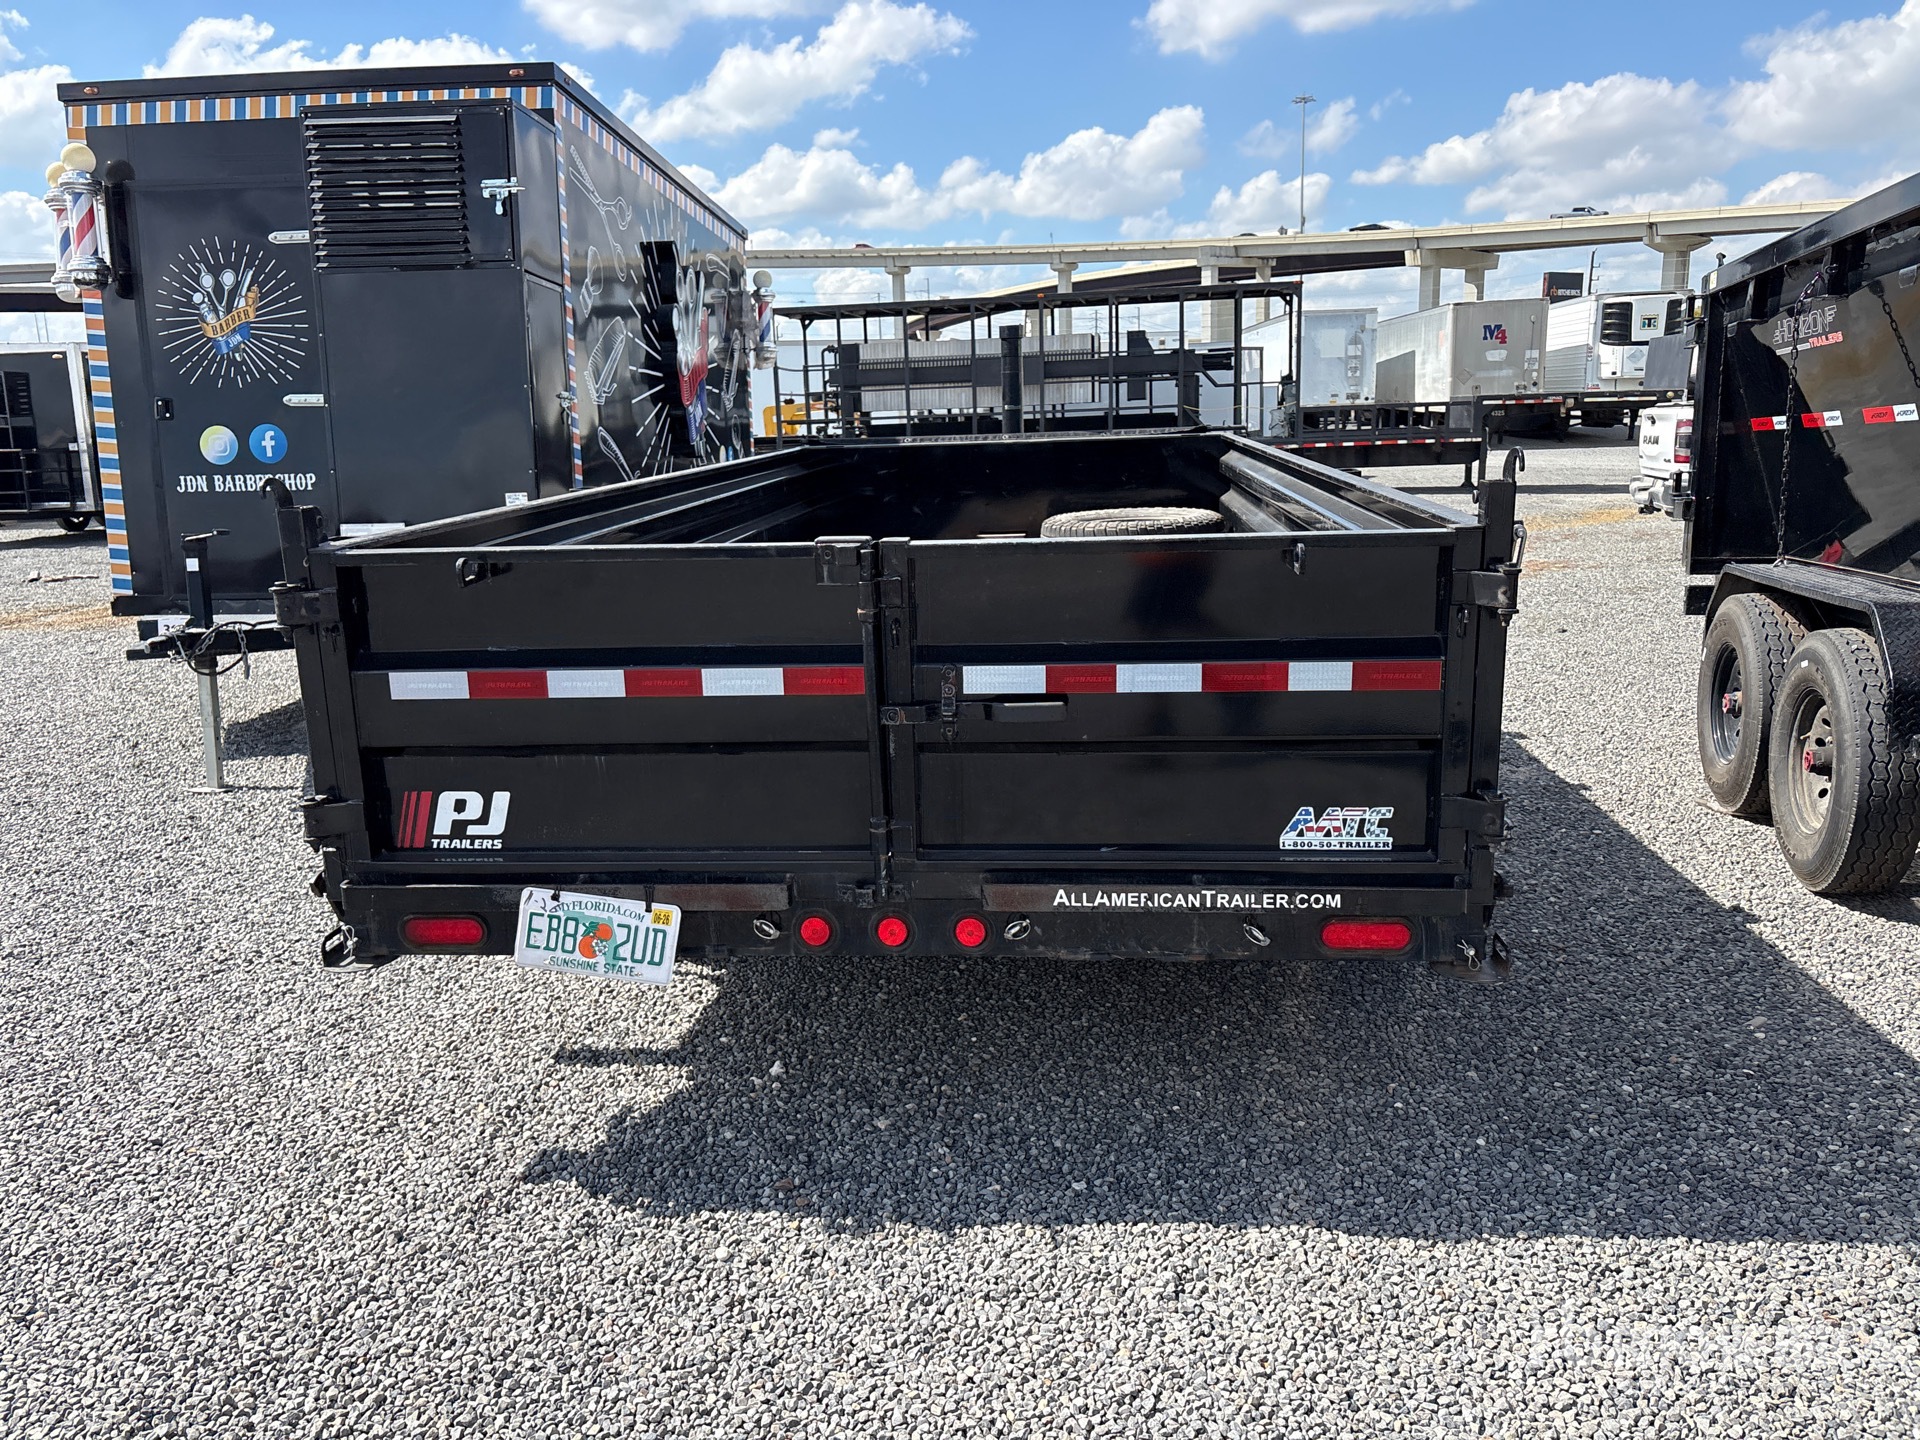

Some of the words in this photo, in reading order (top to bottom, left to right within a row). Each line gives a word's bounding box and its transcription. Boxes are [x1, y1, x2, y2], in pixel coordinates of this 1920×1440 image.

[211, 308, 251, 336] BARBER
[228, 333, 243, 347] JDN
[1482, 323, 1508, 345] M4
[1809, 331, 1843, 348] TRAILERS
[1642, 435, 1660, 446] RAM
[177, 475, 208, 493] JDN
[433, 791, 511, 836] PJ
[1281, 807, 1394, 839] AATC
[431, 839, 502, 849] TRAILERS
[1282, 841, 1391, 849] 1-800-50-TRAILER
[653, 913, 670, 925] 06-26
[548, 956, 599, 972] SUNSHINE
[603, 962, 635, 977] STATE
